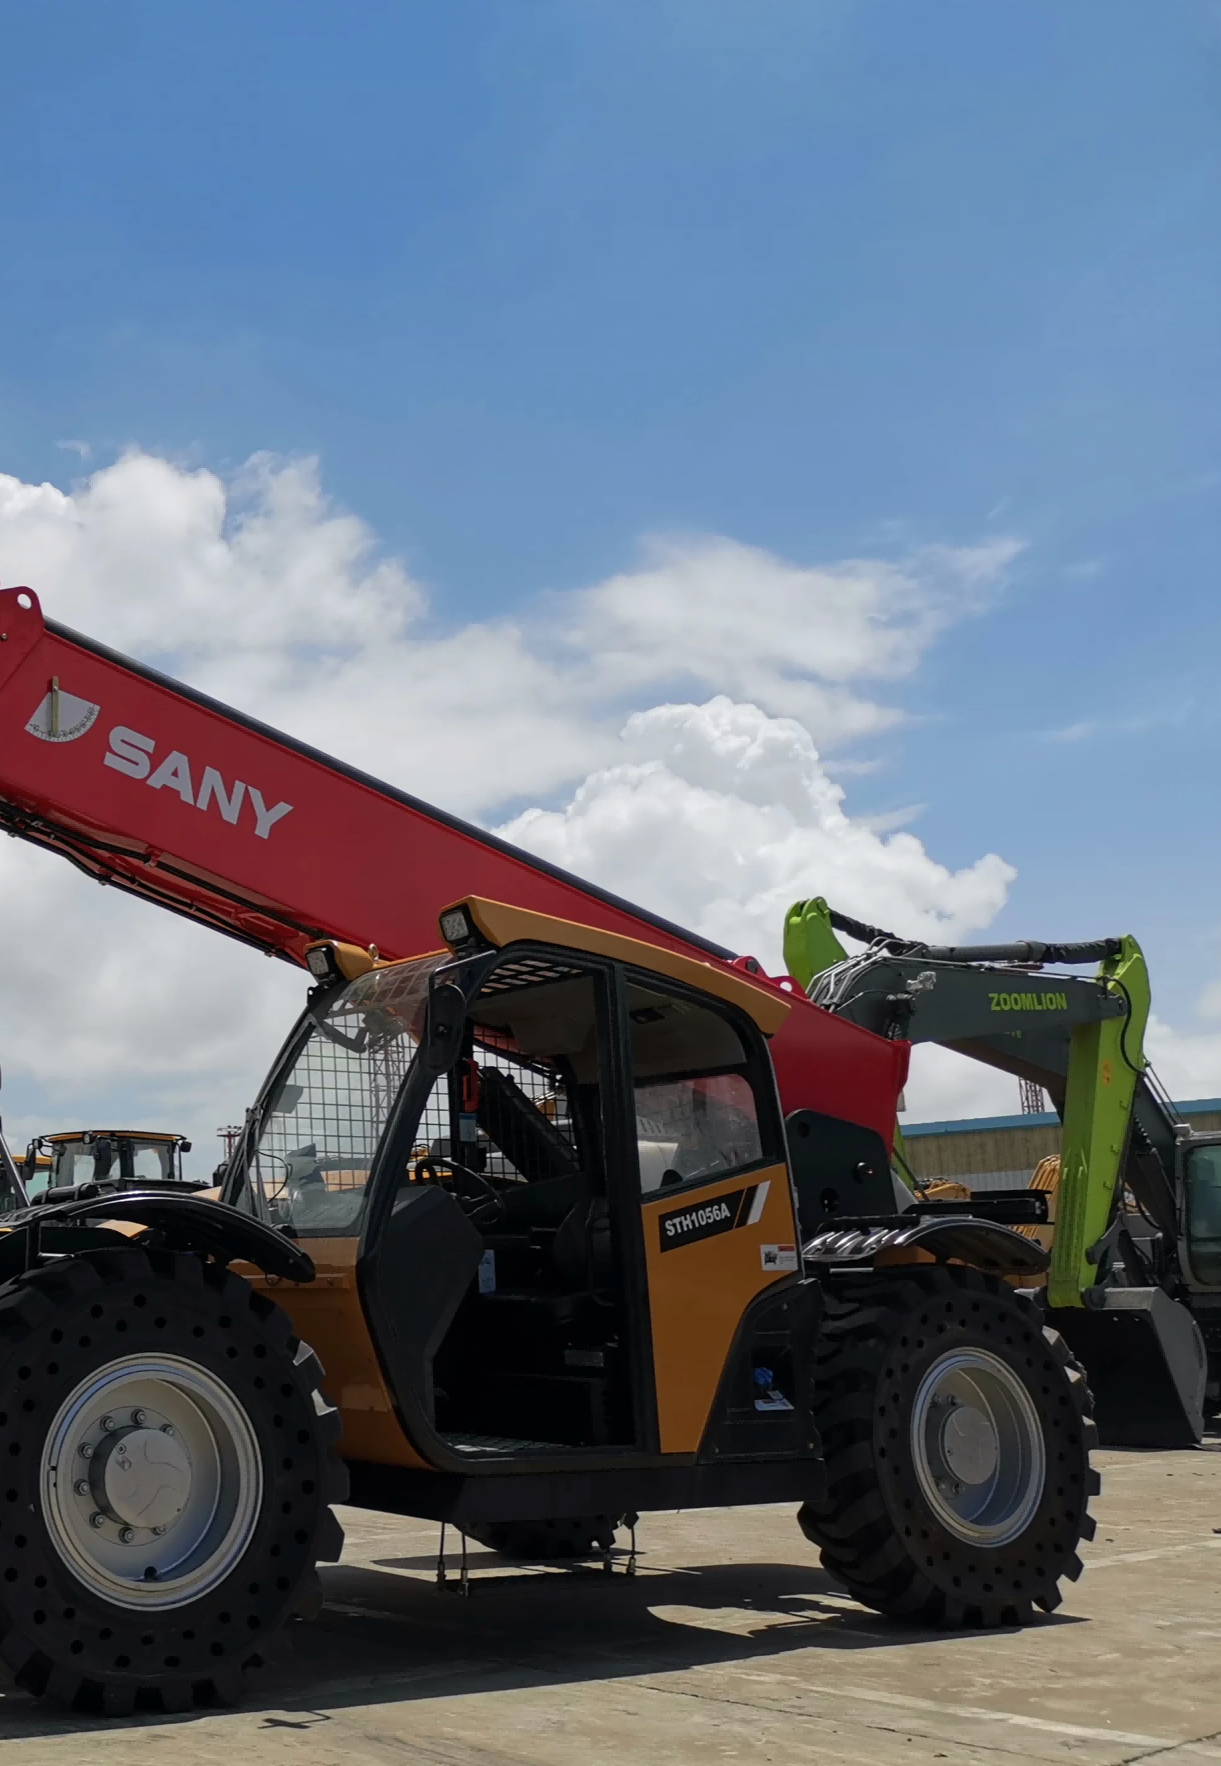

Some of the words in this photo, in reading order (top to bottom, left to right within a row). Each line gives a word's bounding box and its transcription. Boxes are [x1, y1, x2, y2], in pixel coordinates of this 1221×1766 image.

[103, 725, 294, 840] SANY
[988, 992, 1068, 1010] ZOOMLION
[665, 1203, 731, 1237] STH1056A
